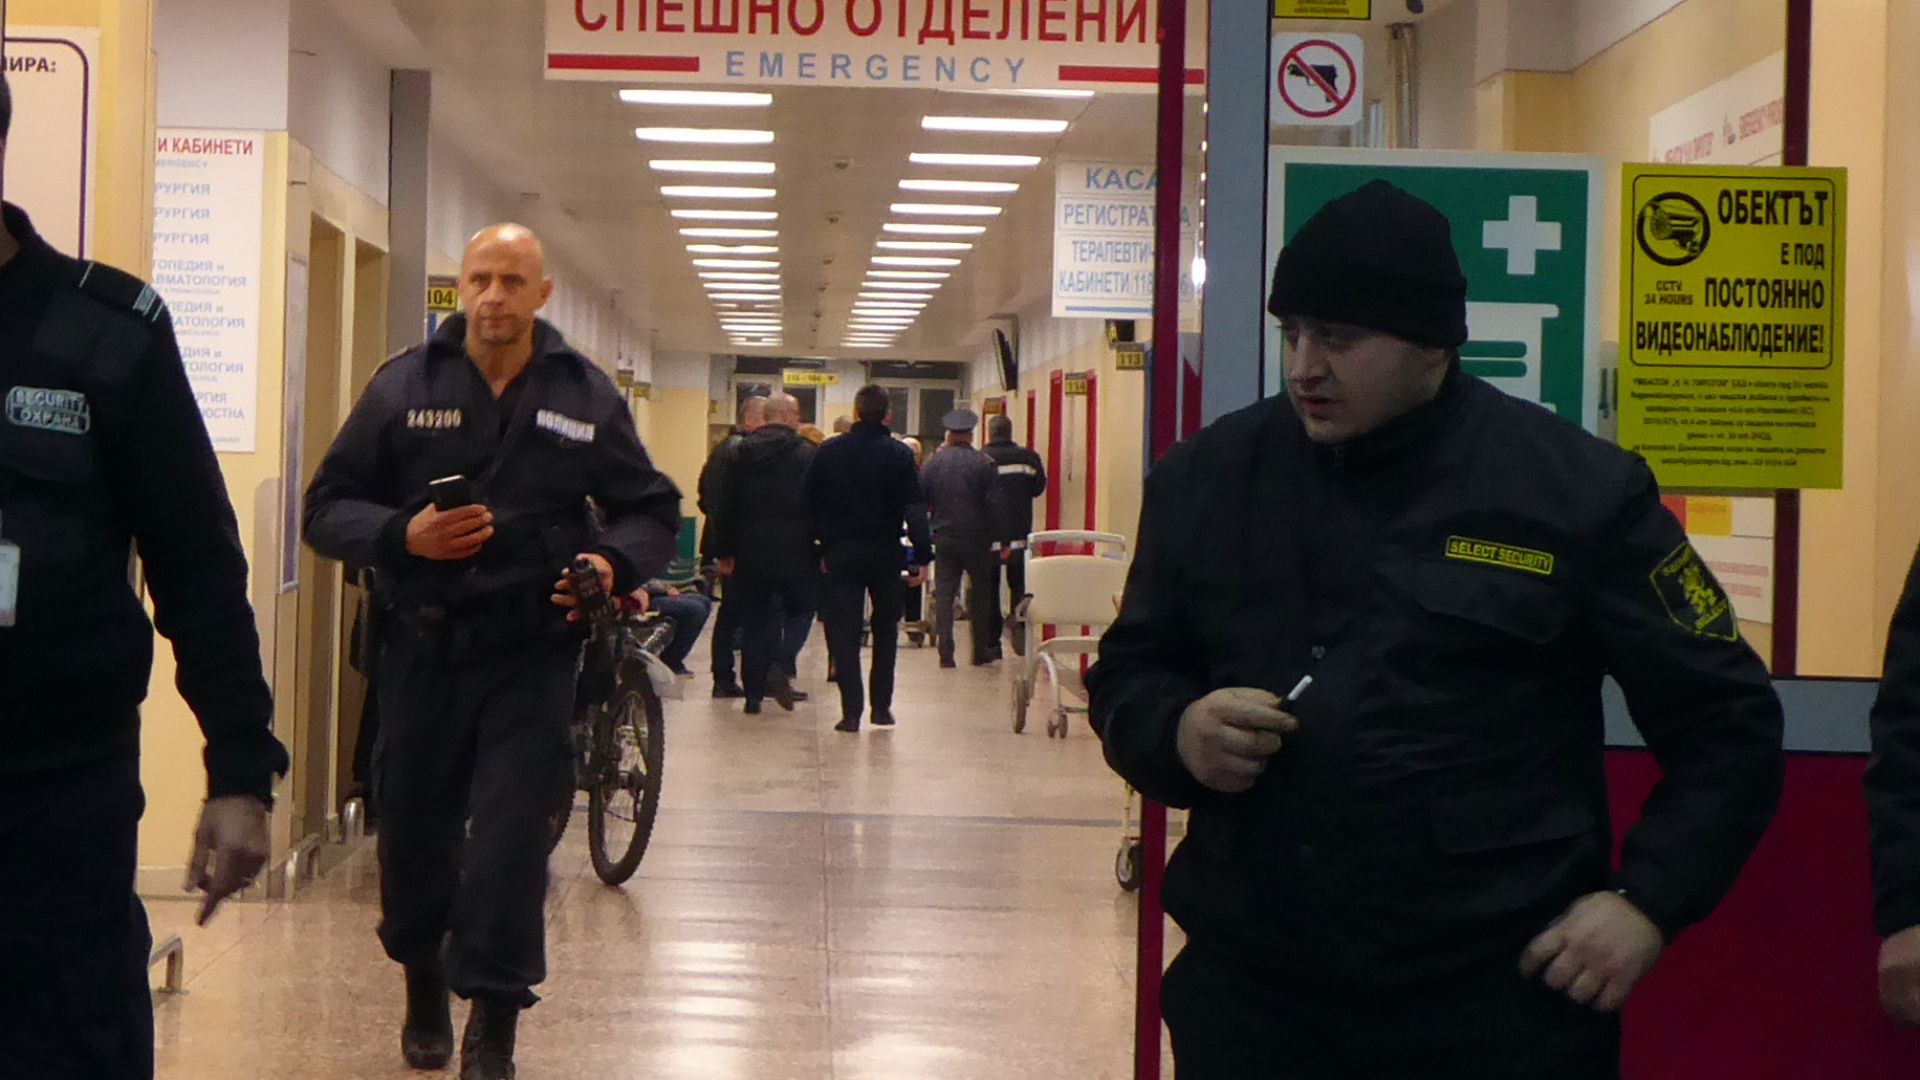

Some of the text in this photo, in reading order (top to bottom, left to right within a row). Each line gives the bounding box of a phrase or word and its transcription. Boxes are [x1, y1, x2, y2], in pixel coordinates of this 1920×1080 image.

[575, 0, 1164, 45] СПЕШНО ОТДЕЛЕНИ
[4, 56, 57, 73] ИРА:
[726, 51, 1025, 82] EMERGENCY
[172, 137, 253, 155] КАБИНЕТИ
[1718, 189, 1828, 226] ОБЕКТЪТ
[1781, 243, 1825, 269] Е ПОД
[153, 273, 247, 287] ВМАТОЛОГИЯ
[1059, 271, 1130, 293] КАБИНЕТИ
[1656, 280, 1683, 291] CCTV
[1660, 294, 1693, 306] HOURS
[1705, 277, 1825, 309] ПОСТОЯННО
[172, 315, 245, 329] АТОЛОГИЯ
[1636, 321, 1825, 358] ВИДЕОНАБЛЮДЕНИЕ!
[1450, 541, 1551, 571] SELECT SECURITY
